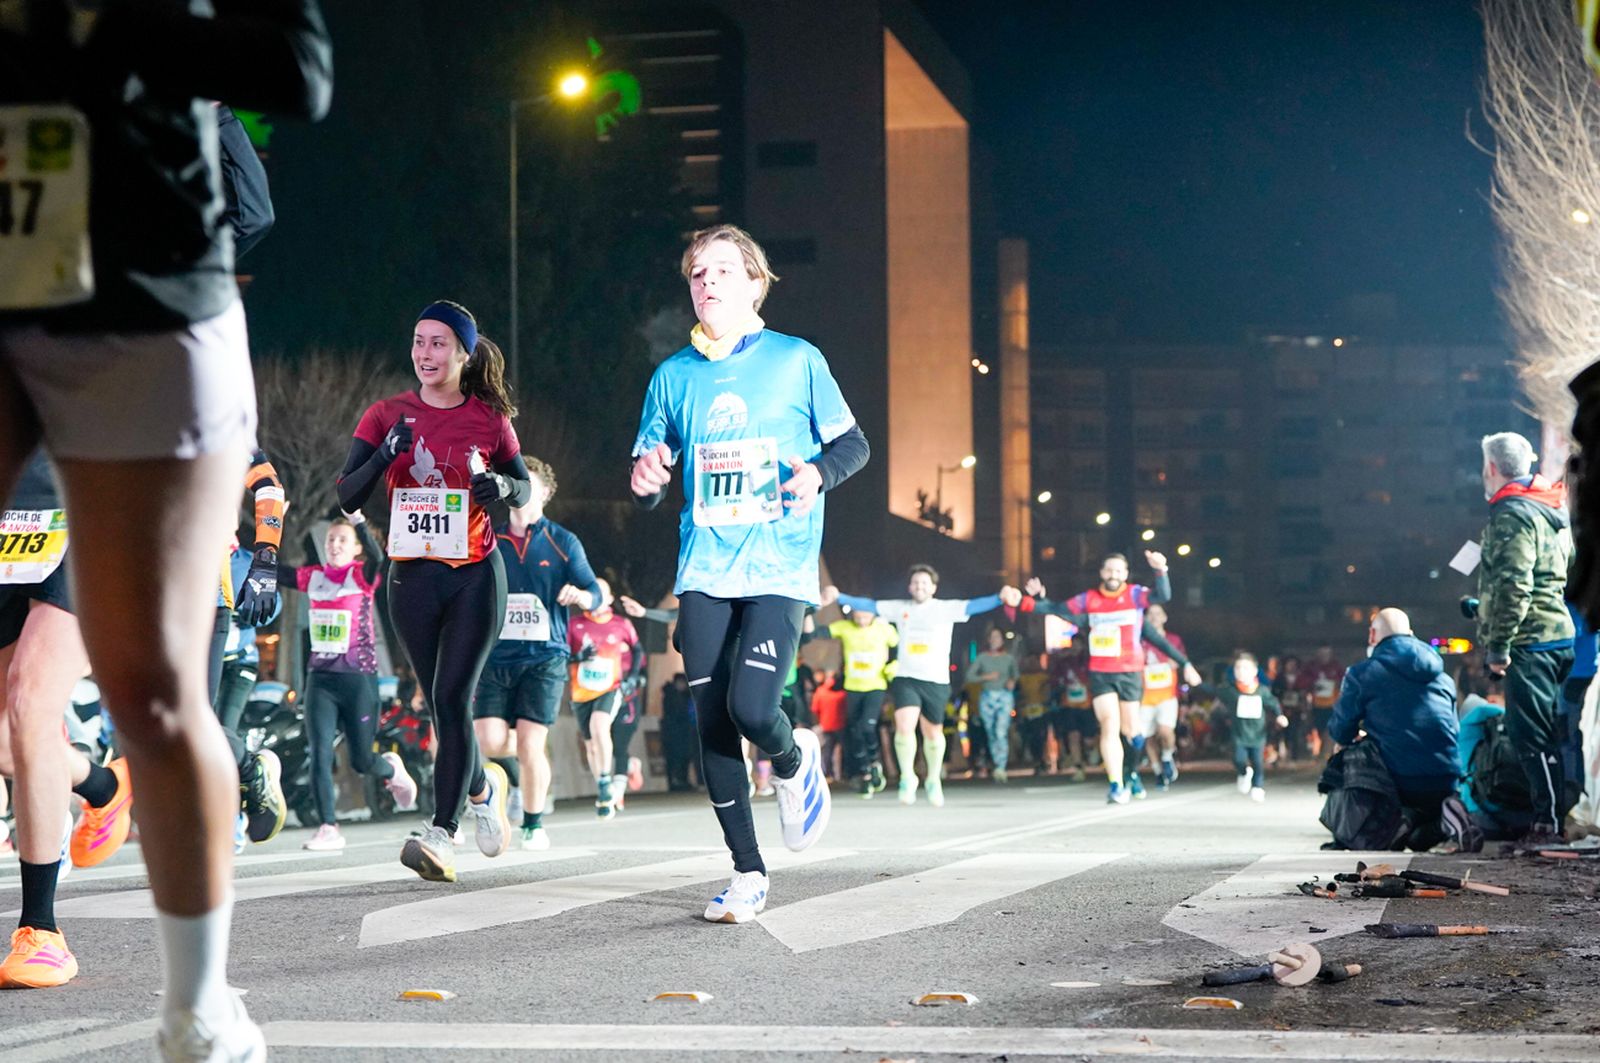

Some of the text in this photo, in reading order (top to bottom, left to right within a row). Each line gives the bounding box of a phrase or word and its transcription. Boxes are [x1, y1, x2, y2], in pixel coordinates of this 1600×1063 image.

[710, 471, 743, 497] 777
[400, 503, 413, 511] SAN
[4, 511, 42, 522] OCHE DE
[408, 513, 449, 534] 3411
[508, 610, 540, 624] 2395
